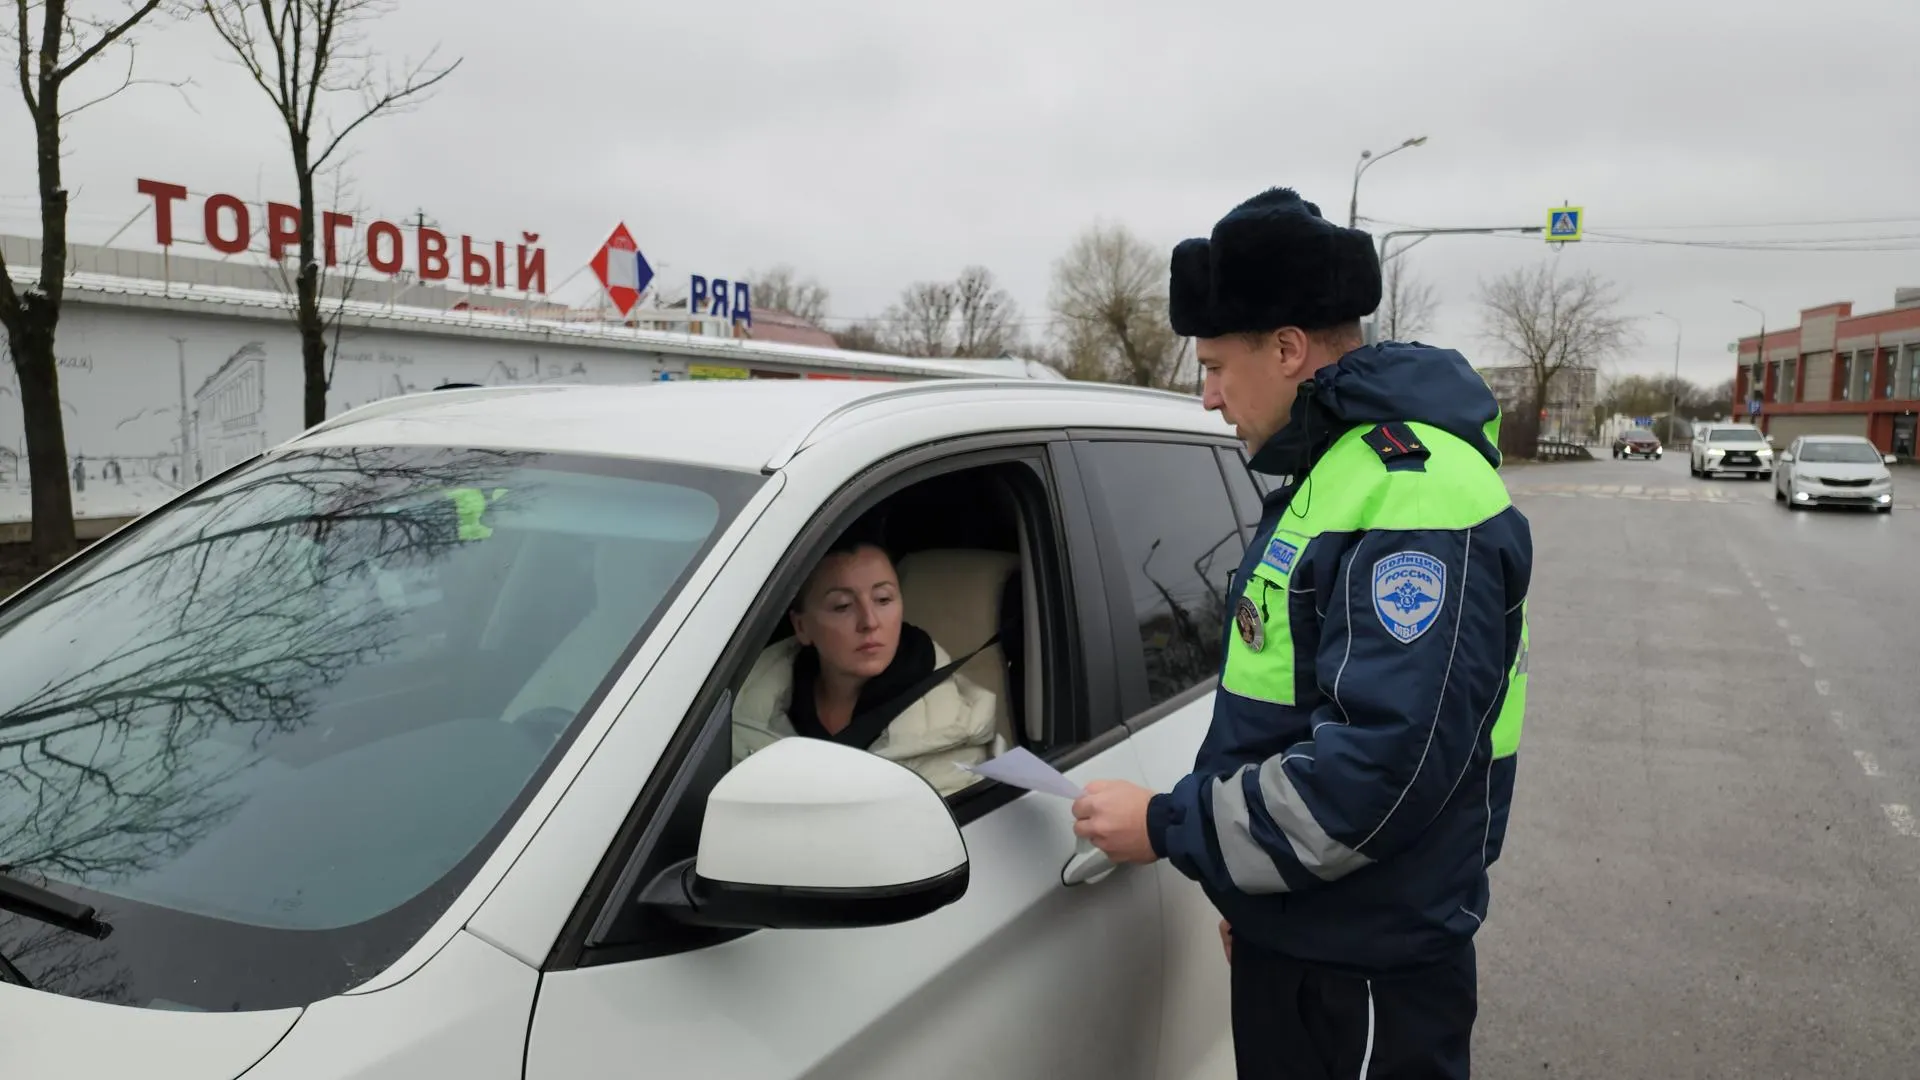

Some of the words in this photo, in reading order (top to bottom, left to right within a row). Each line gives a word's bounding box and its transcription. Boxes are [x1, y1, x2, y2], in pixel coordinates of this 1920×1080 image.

[137, 178, 547, 294] ТОРГОВЫЙ
[691, 274, 752, 328] РЯД
[1379, 554, 1441, 575] ПОЛИЦИЯ
[1385, 569, 1433, 585] РОССИЯ
[1394, 623, 1418, 638] МВД
